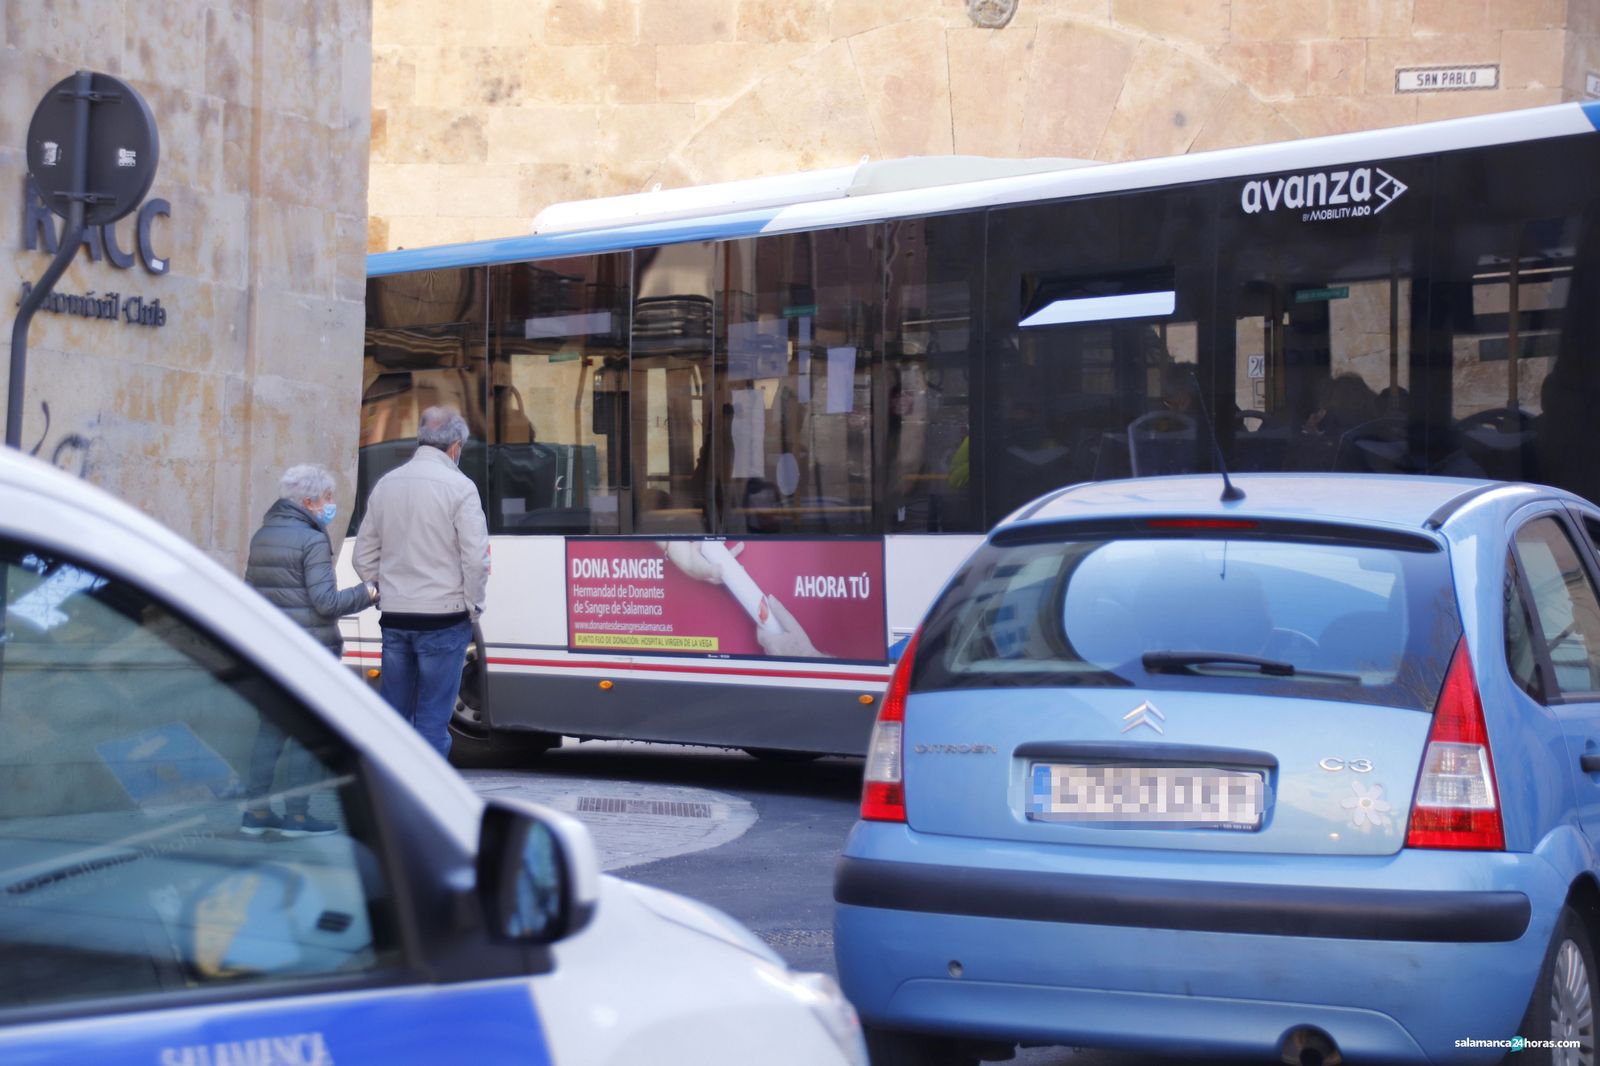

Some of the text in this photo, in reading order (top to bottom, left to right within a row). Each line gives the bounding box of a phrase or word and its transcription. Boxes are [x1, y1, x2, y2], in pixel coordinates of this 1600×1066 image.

[1416, 71, 1477, 86] SAN PABLO
[1241, 167, 1372, 214] avanza
[1302, 205, 1371, 222] BY MOBILITY ADO
[122, 296, 167, 327] Club
[572, 558, 665, 579] DONA SANGRE
[573, 584, 665, 598] Hermandad de Donantes
[794, 571, 870, 599] AHORA TÚ
[573, 600, 663, 616] de Sangre de Salamanca
[574, 621, 673, 633] www.donantesdesangresalamanca.es
[578, 635, 594, 643] PUNTO
[641, 637, 664, 646] HOSPITAL
[665, 638, 684, 647] VIRGEN
[684, 639, 692, 647] DE
[700, 640, 712, 648] VEGA
[1319, 756, 1375, 773] C3
